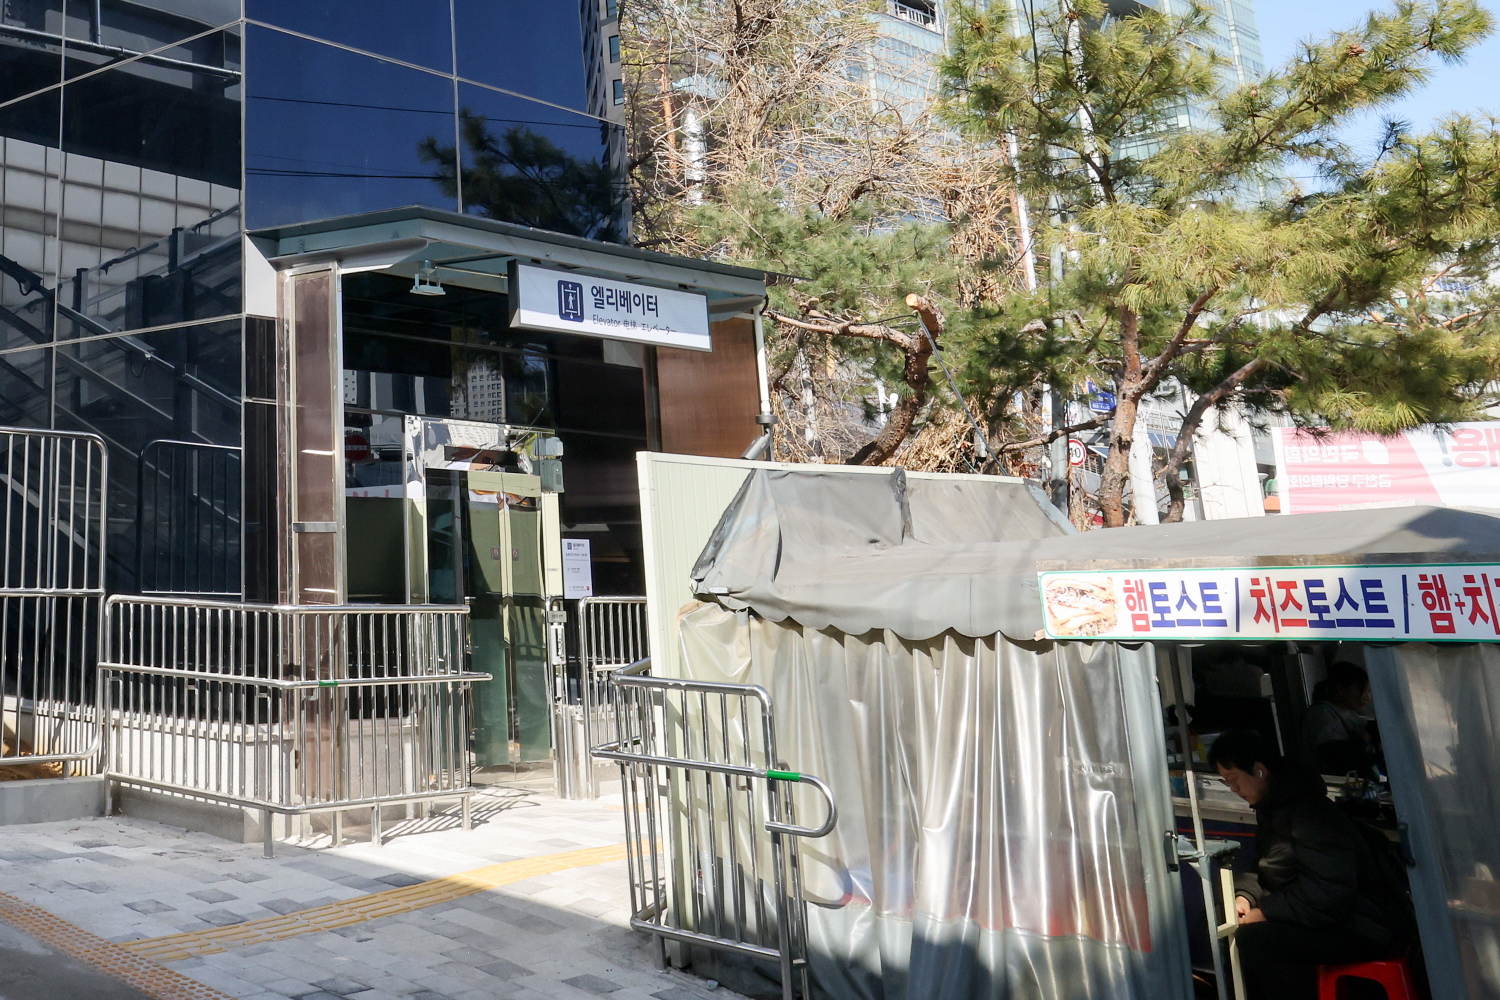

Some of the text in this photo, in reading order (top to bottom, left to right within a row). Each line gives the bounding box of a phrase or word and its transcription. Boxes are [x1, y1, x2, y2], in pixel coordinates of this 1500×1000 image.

[590, 285, 659, 318] 엘리베이터
[592, 314, 621, 328] Elevator
[640, 322, 677, 335] エレベーター
[1122, 573, 1500, 635] 햄토스트 치즈토스트 햄+치
